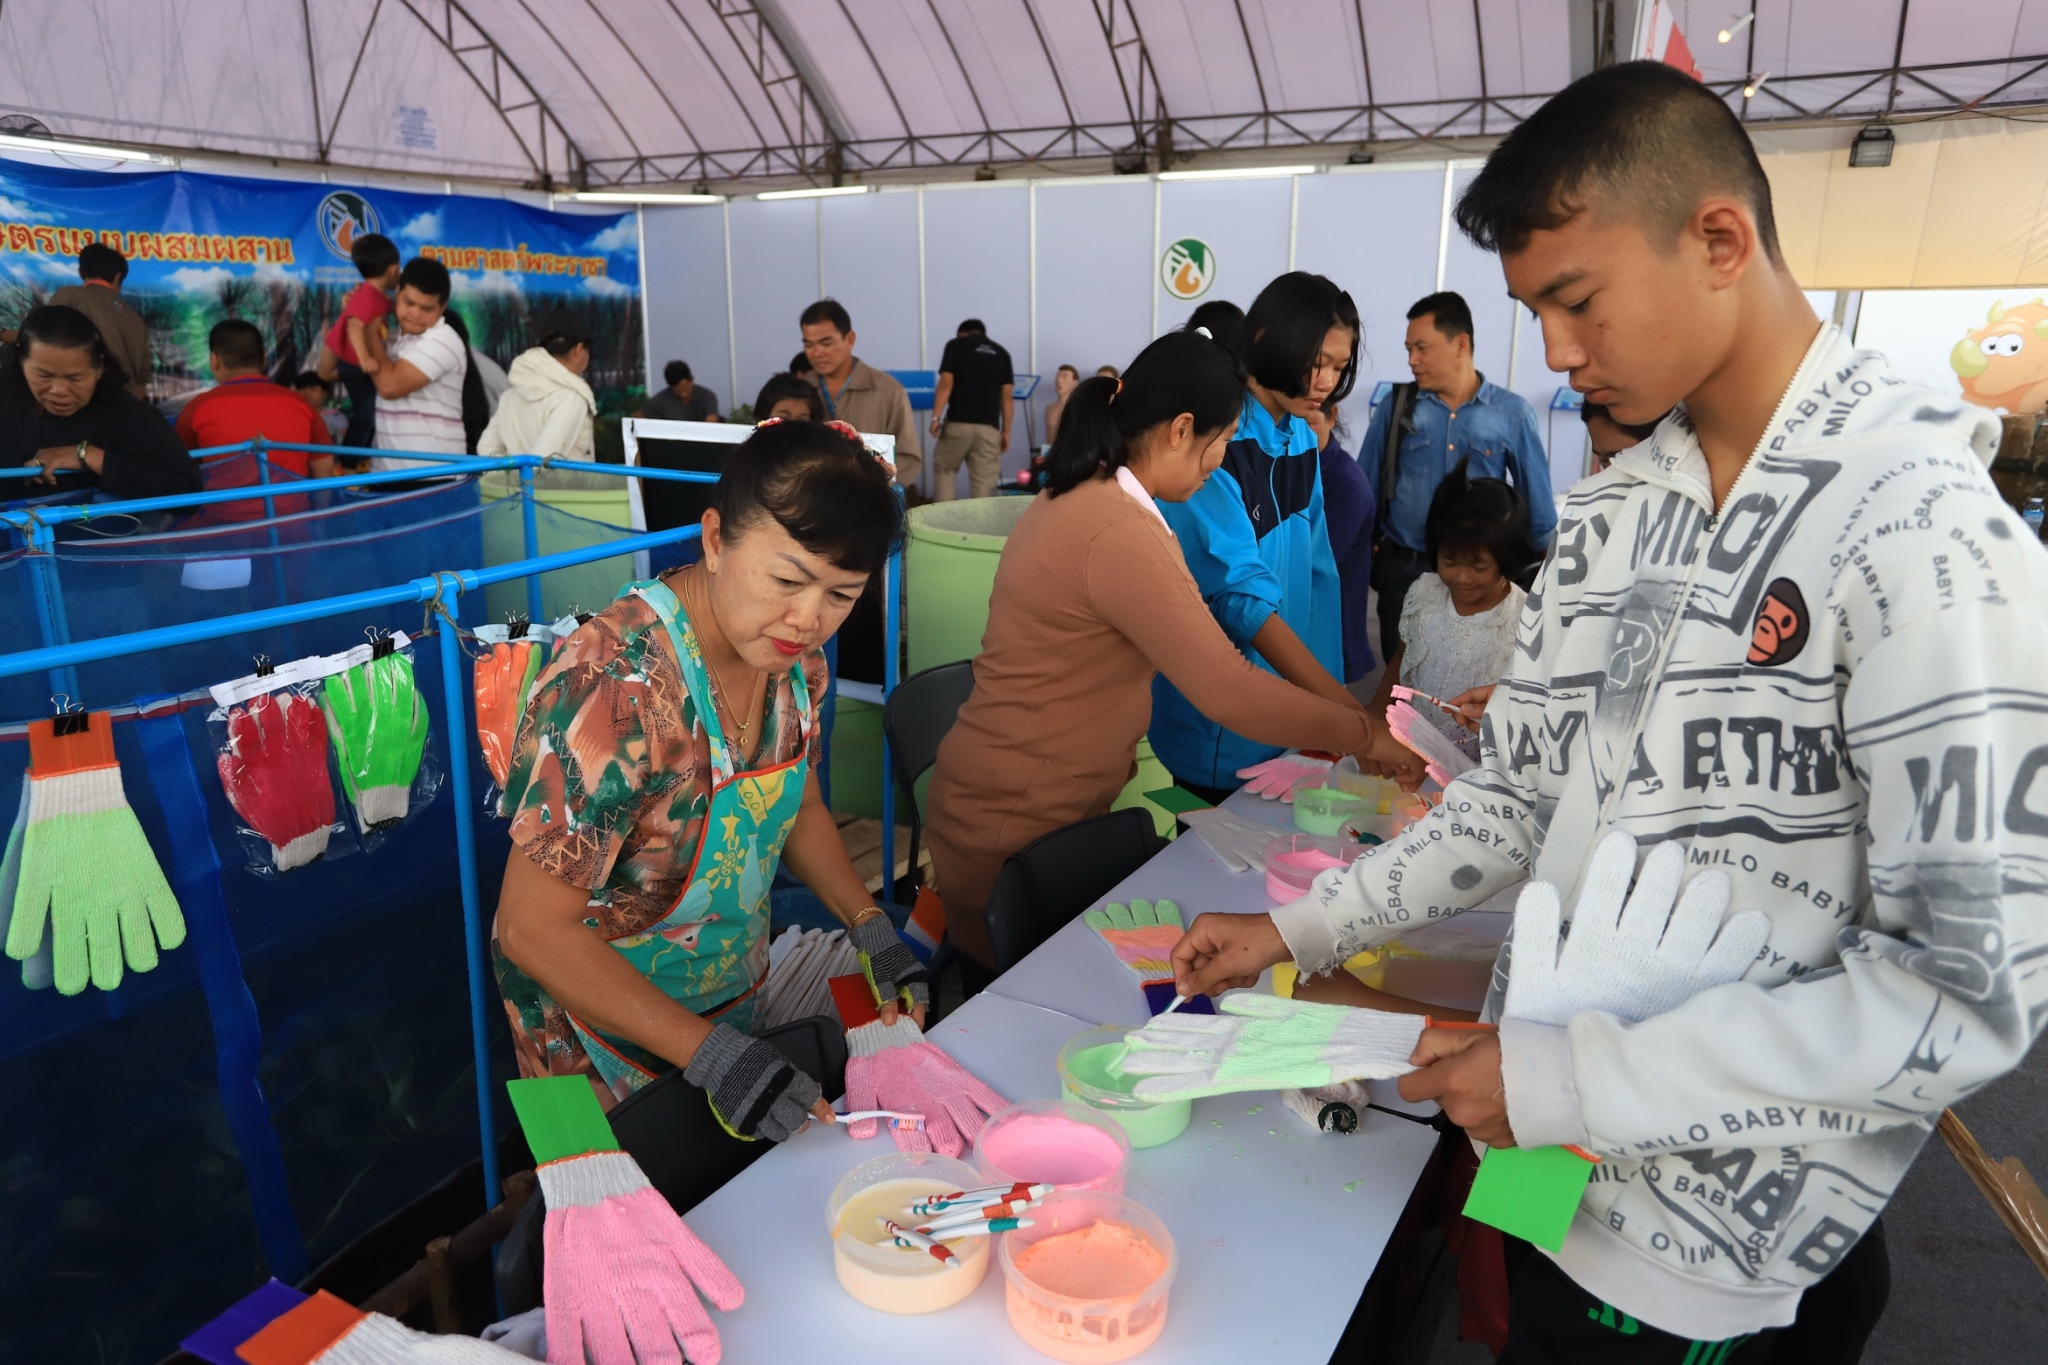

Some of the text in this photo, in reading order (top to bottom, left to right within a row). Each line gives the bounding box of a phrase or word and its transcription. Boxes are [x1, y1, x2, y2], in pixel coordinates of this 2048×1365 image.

[1821, 380, 1873, 437] MILO
[1869, 461, 1916, 492] MILO
[1914, 483, 1950, 518] BABY
[1875, 517, 1933, 538] MILO
[1949, 527, 1993, 571] BABY
[1853, 553, 1883, 595] BABY
[1932, 554, 1955, 599] BABY
[1387, 857, 1407, 909] BABY
[1403, 830, 1443, 859] MILO
[1450, 823, 1507, 848] BABY
[1690, 847, 1758, 873] MILO
[1770, 871, 1853, 919] BABY
[1360, 908, 1410, 926] MILO
[1633, 1123, 1710, 1151] MILO
[1720, 1106, 1806, 1134] BABY
